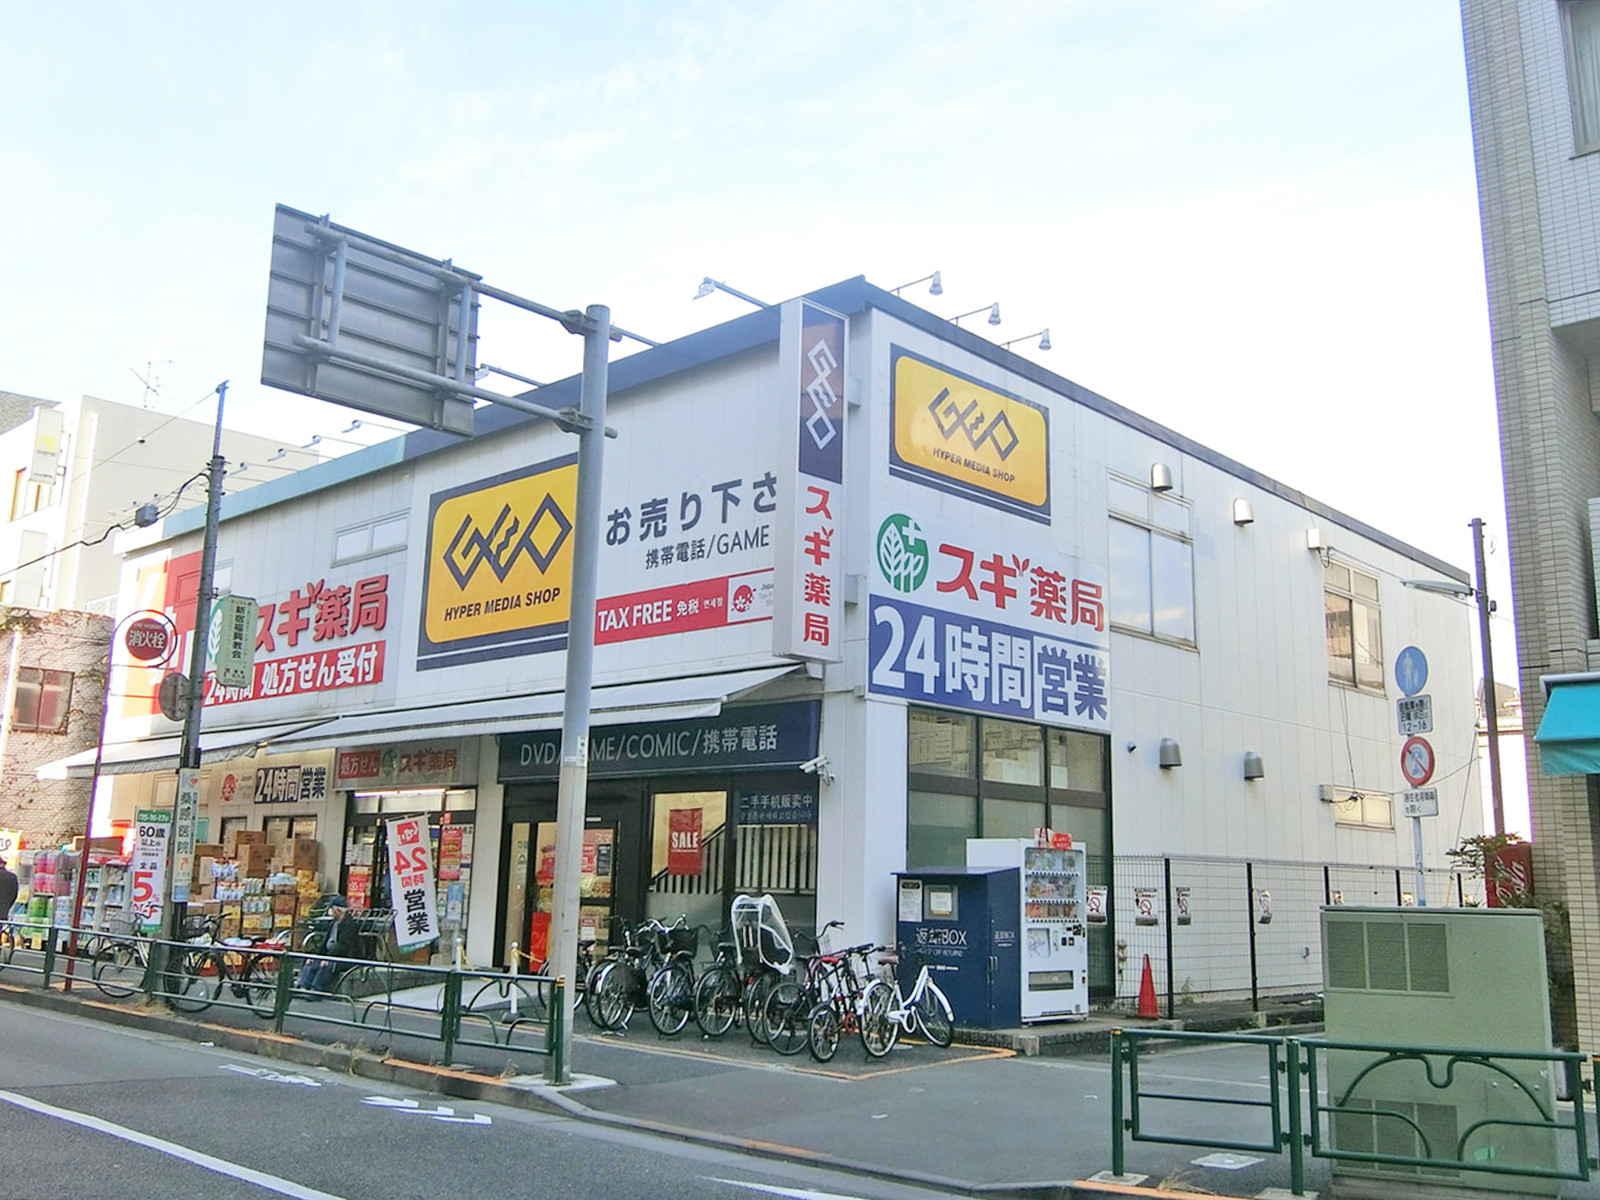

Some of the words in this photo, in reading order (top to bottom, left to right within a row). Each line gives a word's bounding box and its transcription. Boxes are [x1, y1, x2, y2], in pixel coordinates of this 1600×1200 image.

[928, 387, 1019, 462] GEO
[932, 447, 962, 466] HYPER
[963, 458, 991, 476] MEDIA
[991, 467, 1016, 484] SHOP
[442, 492, 573, 592] GEO
[645, 524, 770, 571] 携帯電話/GAME
[802, 485, 836, 648] スギ薬局
[444, 601, 481, 622] HYPER
[484, 593, 522, 615] MEDIA
[525, 586, 561, 606] SHOP
[936, 541, 1105, 633] スギ薬局
[255, 574, 389, 652] スギ薬局
[598, 605, 630, 632] TAX
[632, 598, 673, 627] FREE
[676, 597, 700, 617] 免税
[128, 629, 166, 649] 消火栓
[871, 603, 1109, 721] 24時間営業
[260, 643, 378, 697] 処方せん受付
[255, 766, 327, 803] 24時間営業
[671, 831, 699, 849] SALE
